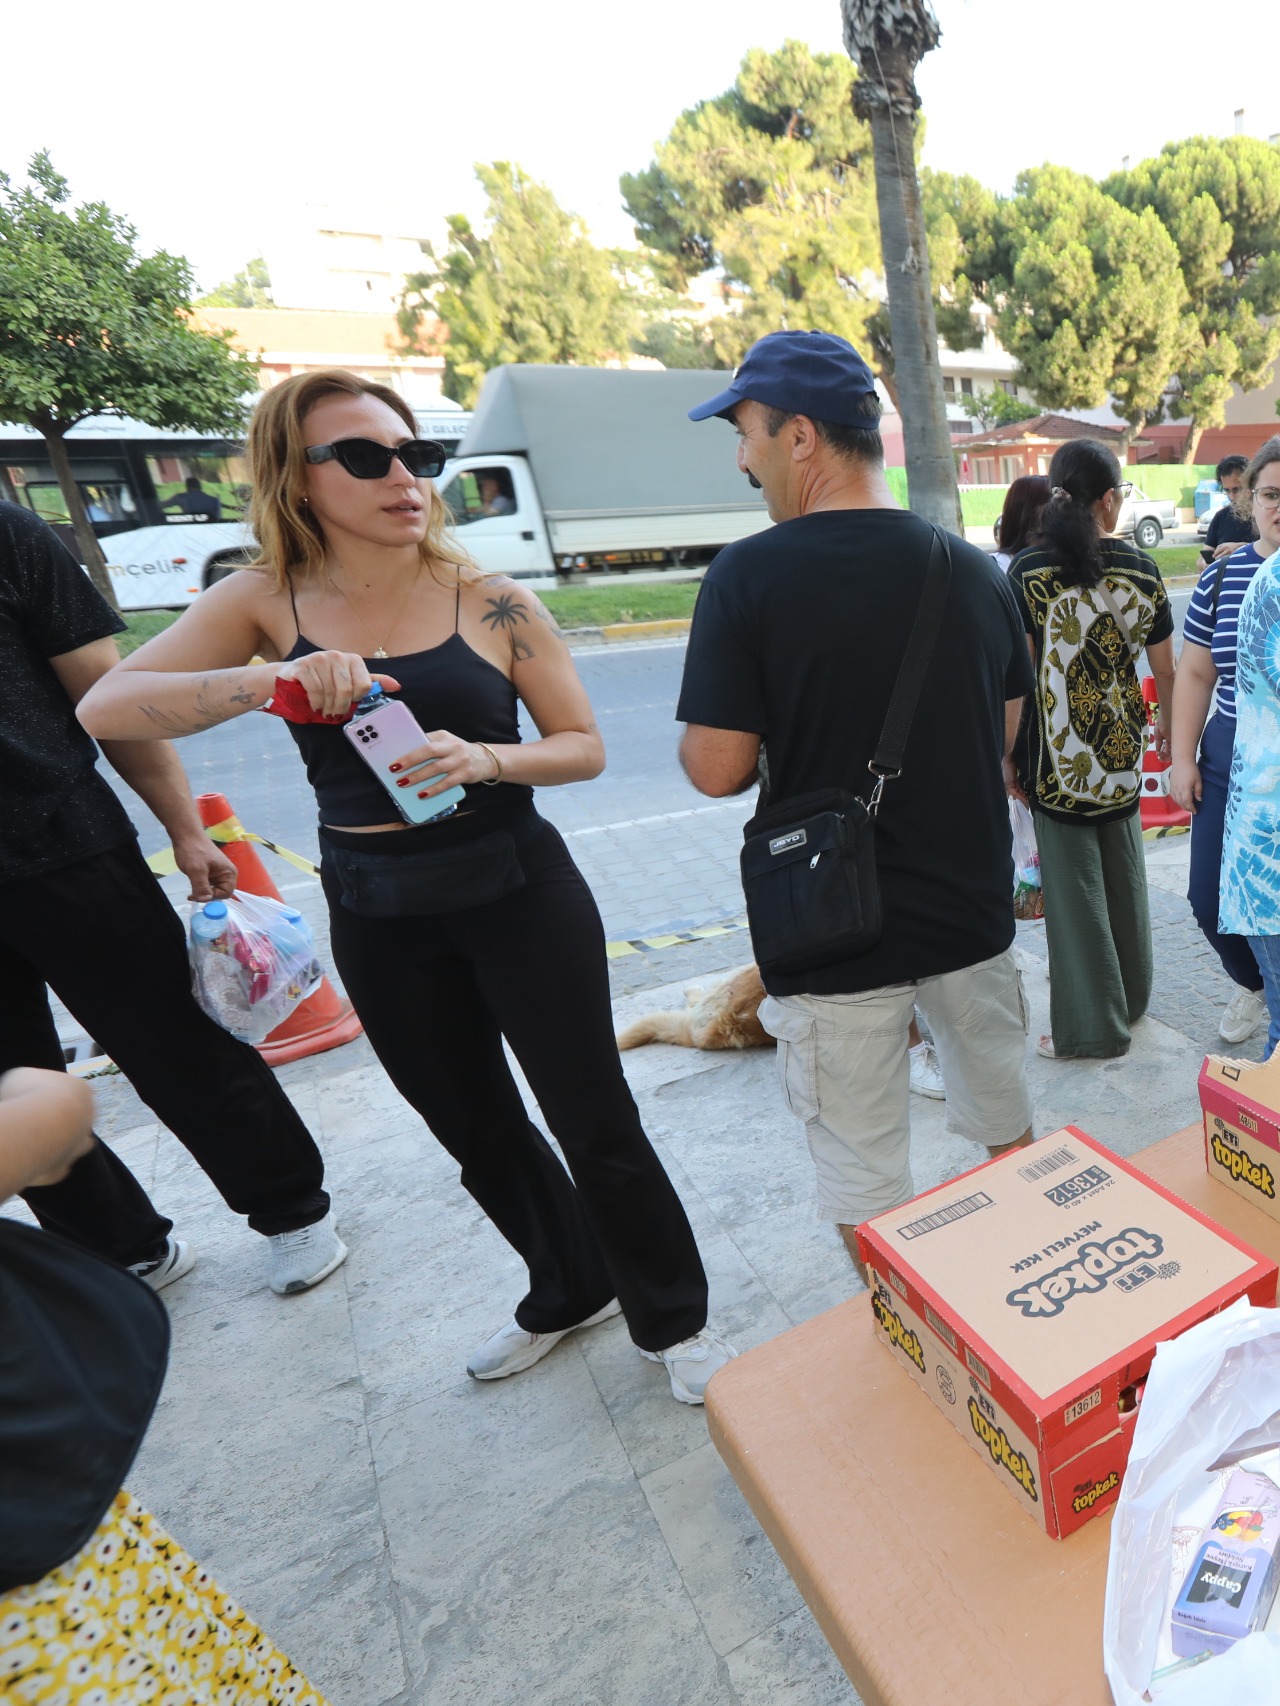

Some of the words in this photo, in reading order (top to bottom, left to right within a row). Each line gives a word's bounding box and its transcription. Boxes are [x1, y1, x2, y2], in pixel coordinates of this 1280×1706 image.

[1211, 1134, 1275, 1199] topkek
[1047, 1171, 1099, 1204] 13612
[1087, 1184, 1105, 1197] Adet
[1104, 1179, 1116, 1188] 24
[1071, 1198, 1082, 1207] 40
[1042, 1220, 1102, 1259] MEYVELİ
[1006, 1228, 1164, 1317] topkek
[1009, 1253, 1043, 1274] KEK
[1071, 1391, 1101, 1419] 13612
[967, 1396, 1038, 1502] topkek
[1072, 1472, 1119, 1513] topkek
[1200, 1572, 1241, 1593] Cappy
